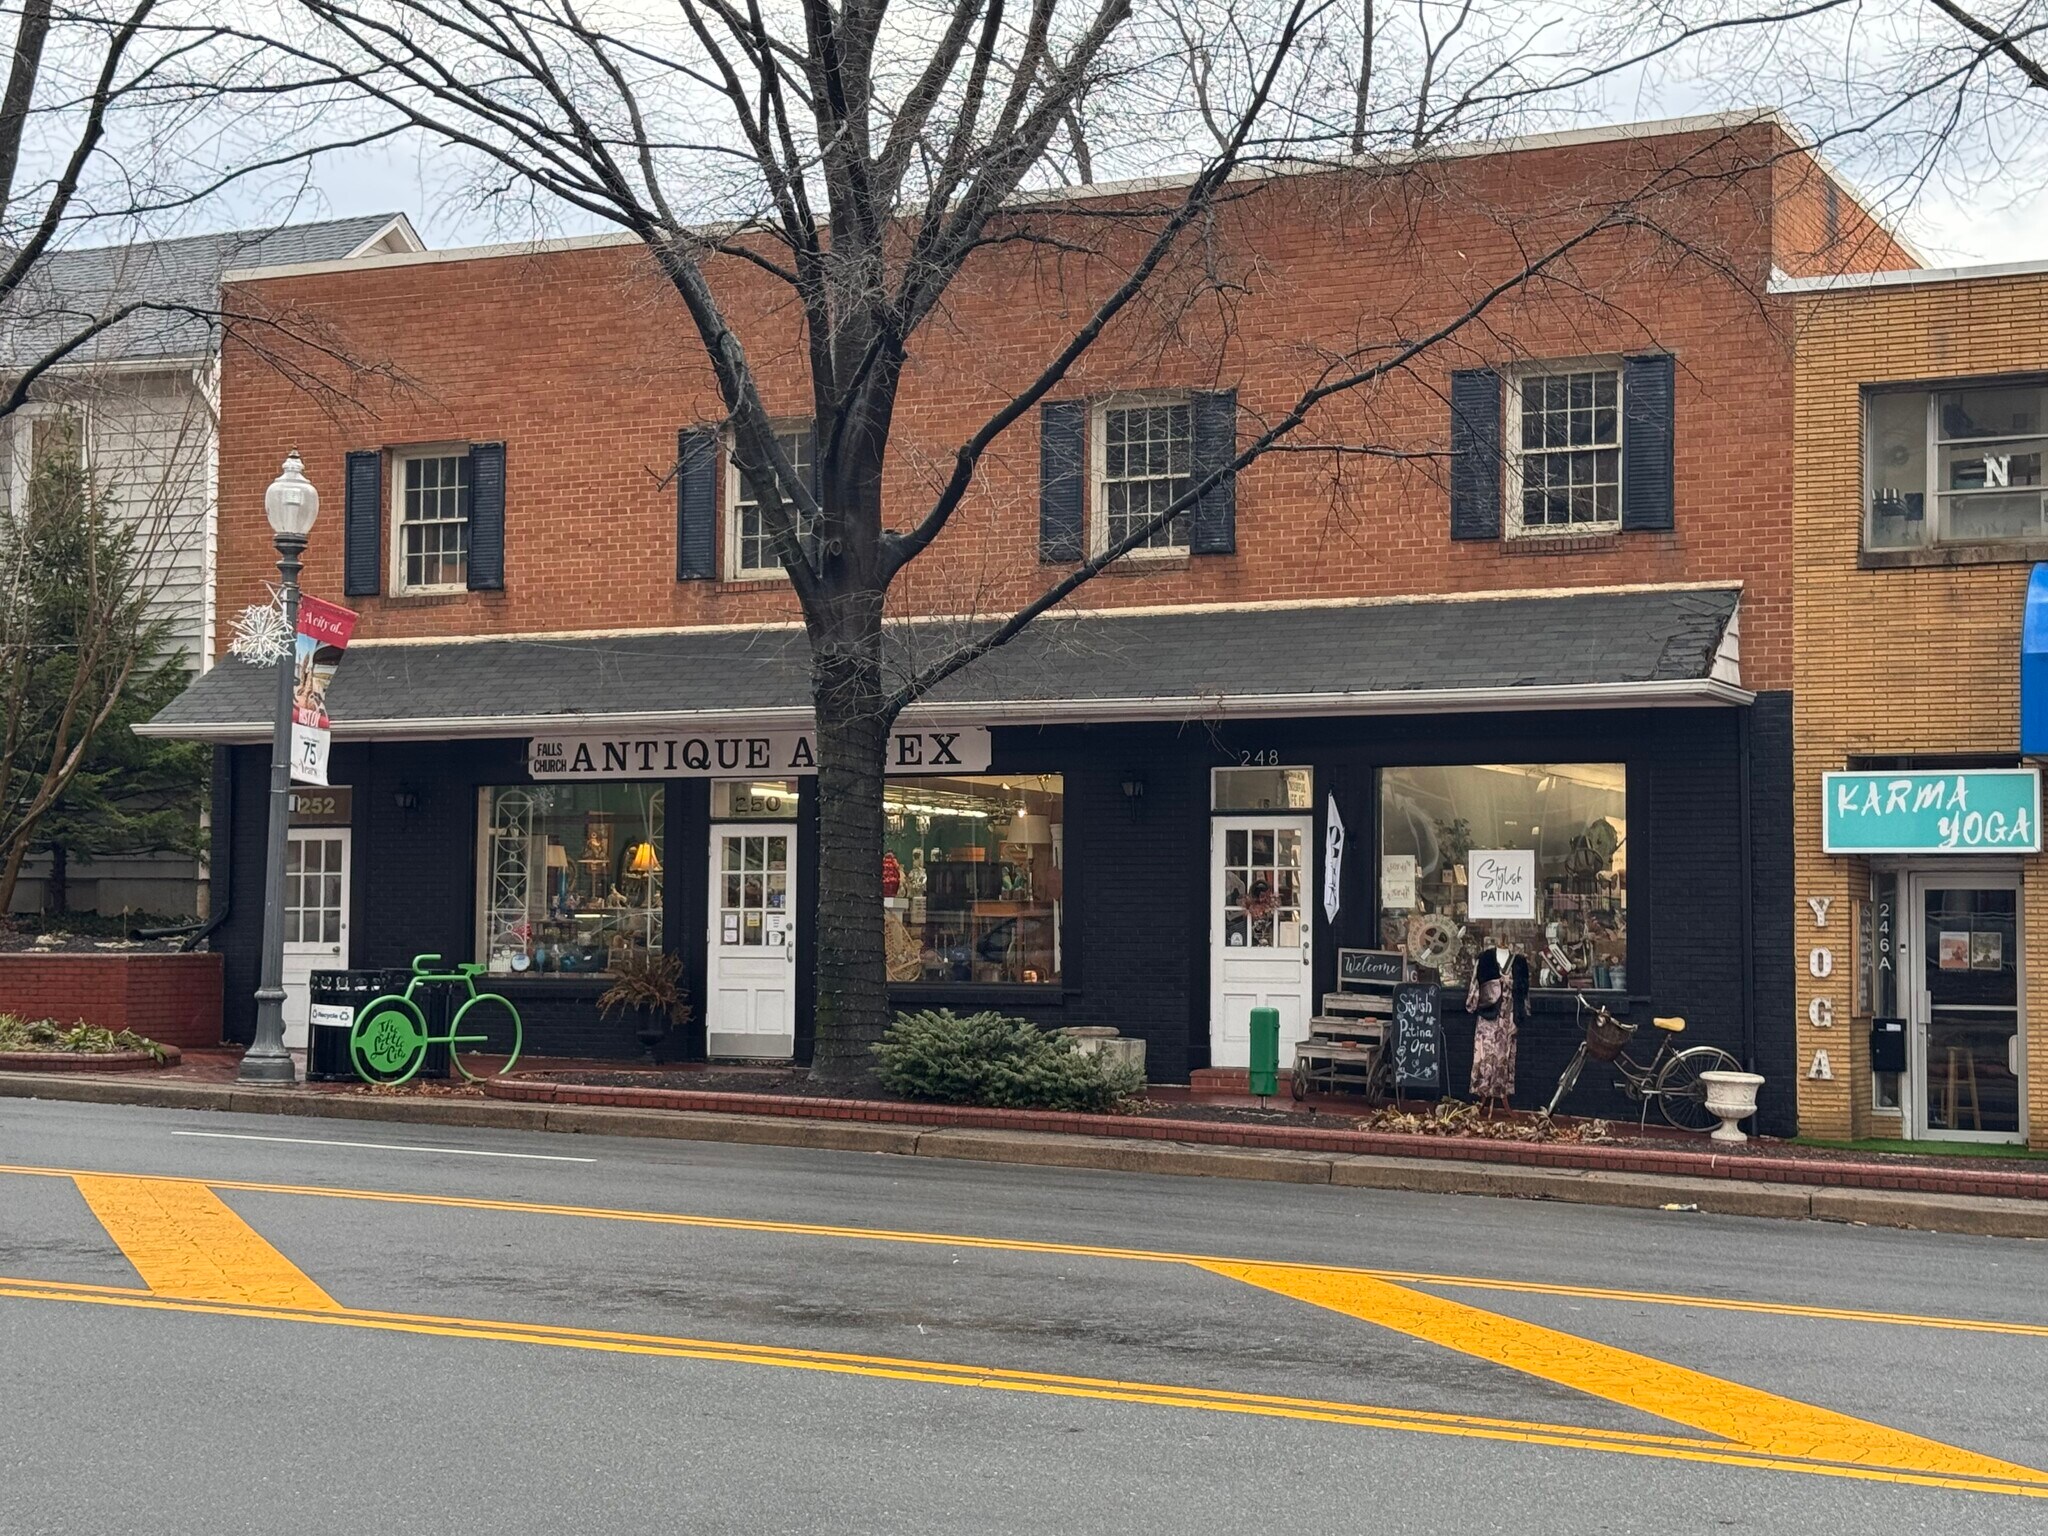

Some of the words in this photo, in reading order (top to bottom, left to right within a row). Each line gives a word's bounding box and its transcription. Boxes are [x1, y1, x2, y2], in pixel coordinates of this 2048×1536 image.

[303, 741, 317, 765] 75
[536, 742, 563, 757] FALLS
[569, 738, 770, 773] ANTIQUE
[788, 733, 962, 768] AEX
[1241, 749, 1279, 767] 248
[533, 758, 567, 773] CHURCH
[299, 797, 336, 815] 252
[735, 795, 782, 812] 250
[1837, 776, 1970, 819] KARMA
[1937, 806, 2032, 849] YOGA
[1476, 858, 1523, 889] Stylish
[1480, 890, 1523, 902] PATINA
[1879, 903, 1892, 971] 246A
[1344, 953, 1401, 975] Welcome
[1807, 896, 1835, 1079] YOGA
[317, 1011, 338, 1019] Recycle
[1397, 993, 1432, 1018] Stylish
[379, 1019, 399, 1034] The
[1399, 1018, 1434, 1046] Patina
[370, 1032, 405, 1060] Little
[386, 1045, 406, 1065] City
[1410, 1038, 1436, 1057] Open
